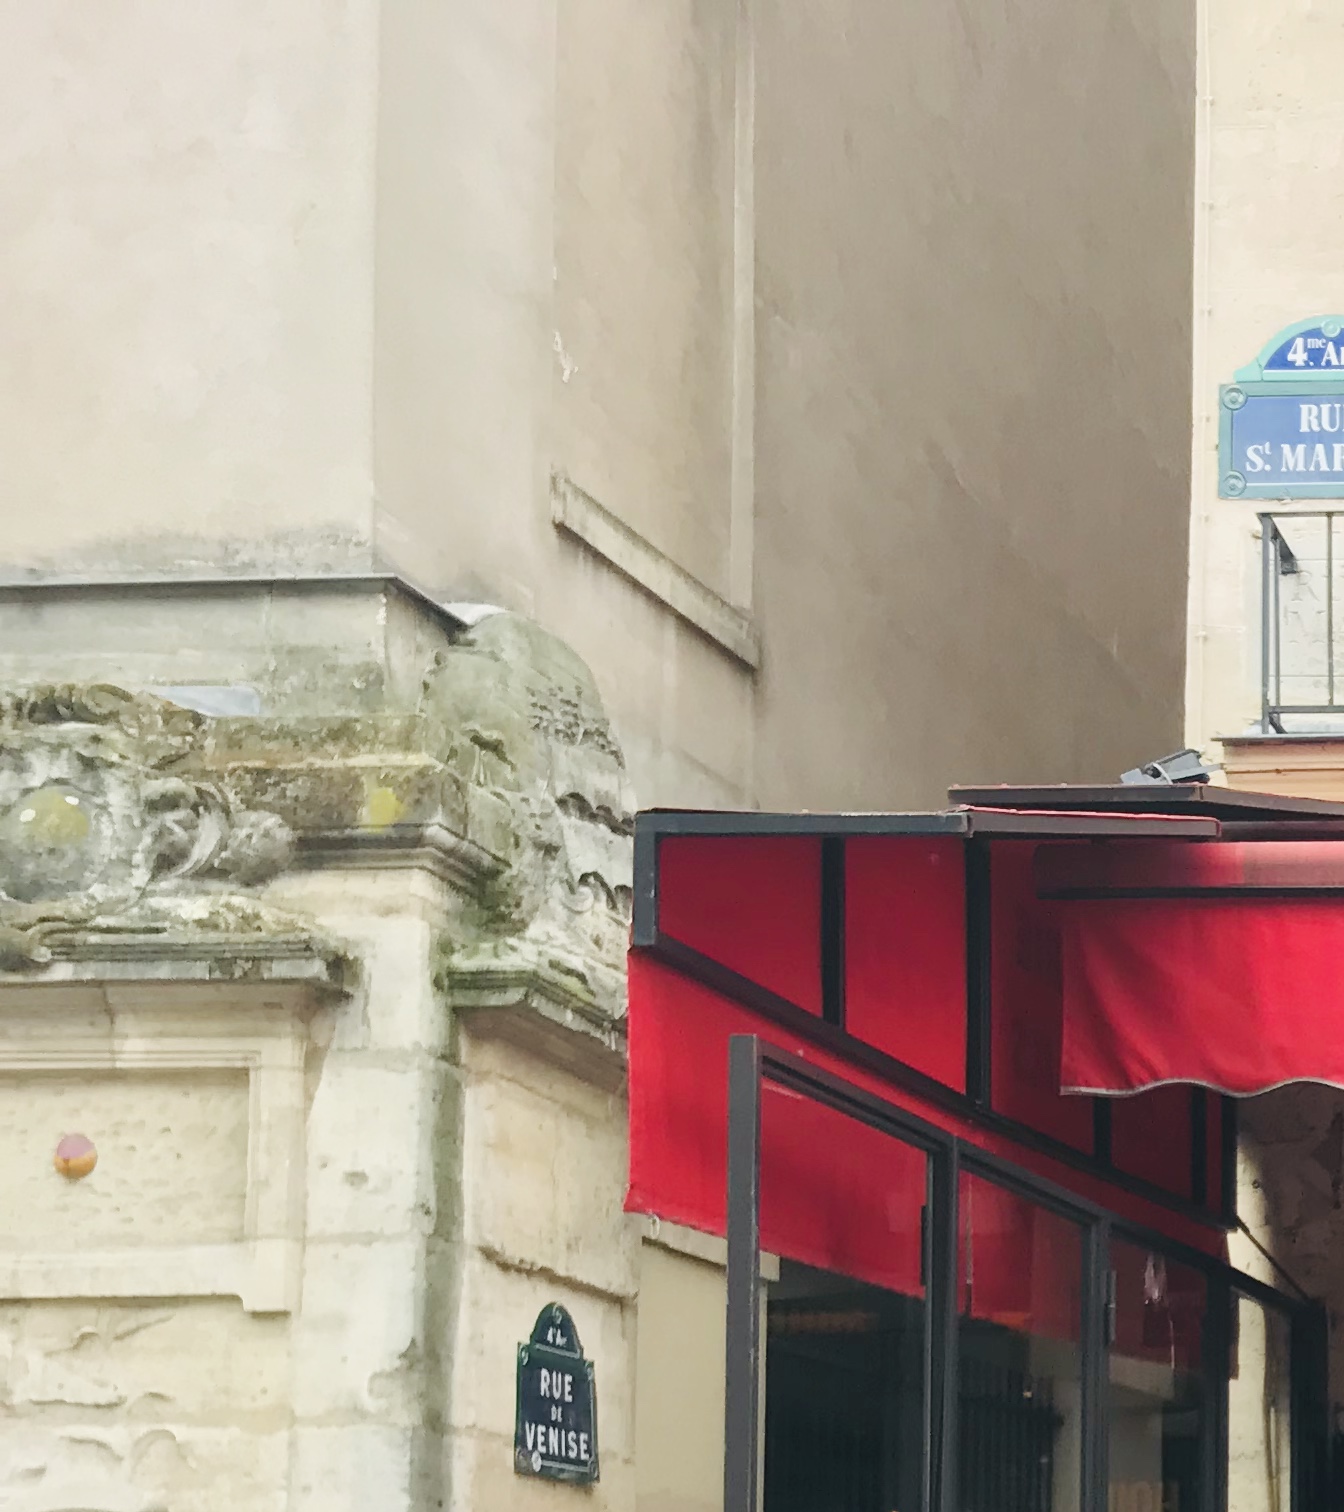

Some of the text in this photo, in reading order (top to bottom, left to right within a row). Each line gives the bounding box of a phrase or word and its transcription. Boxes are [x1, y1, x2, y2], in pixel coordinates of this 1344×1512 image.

[540, 1367, 573, 1403] RUE
[551, 1403, 562, 1423] DE
[525, 1420, 591, 1461] VENISE
